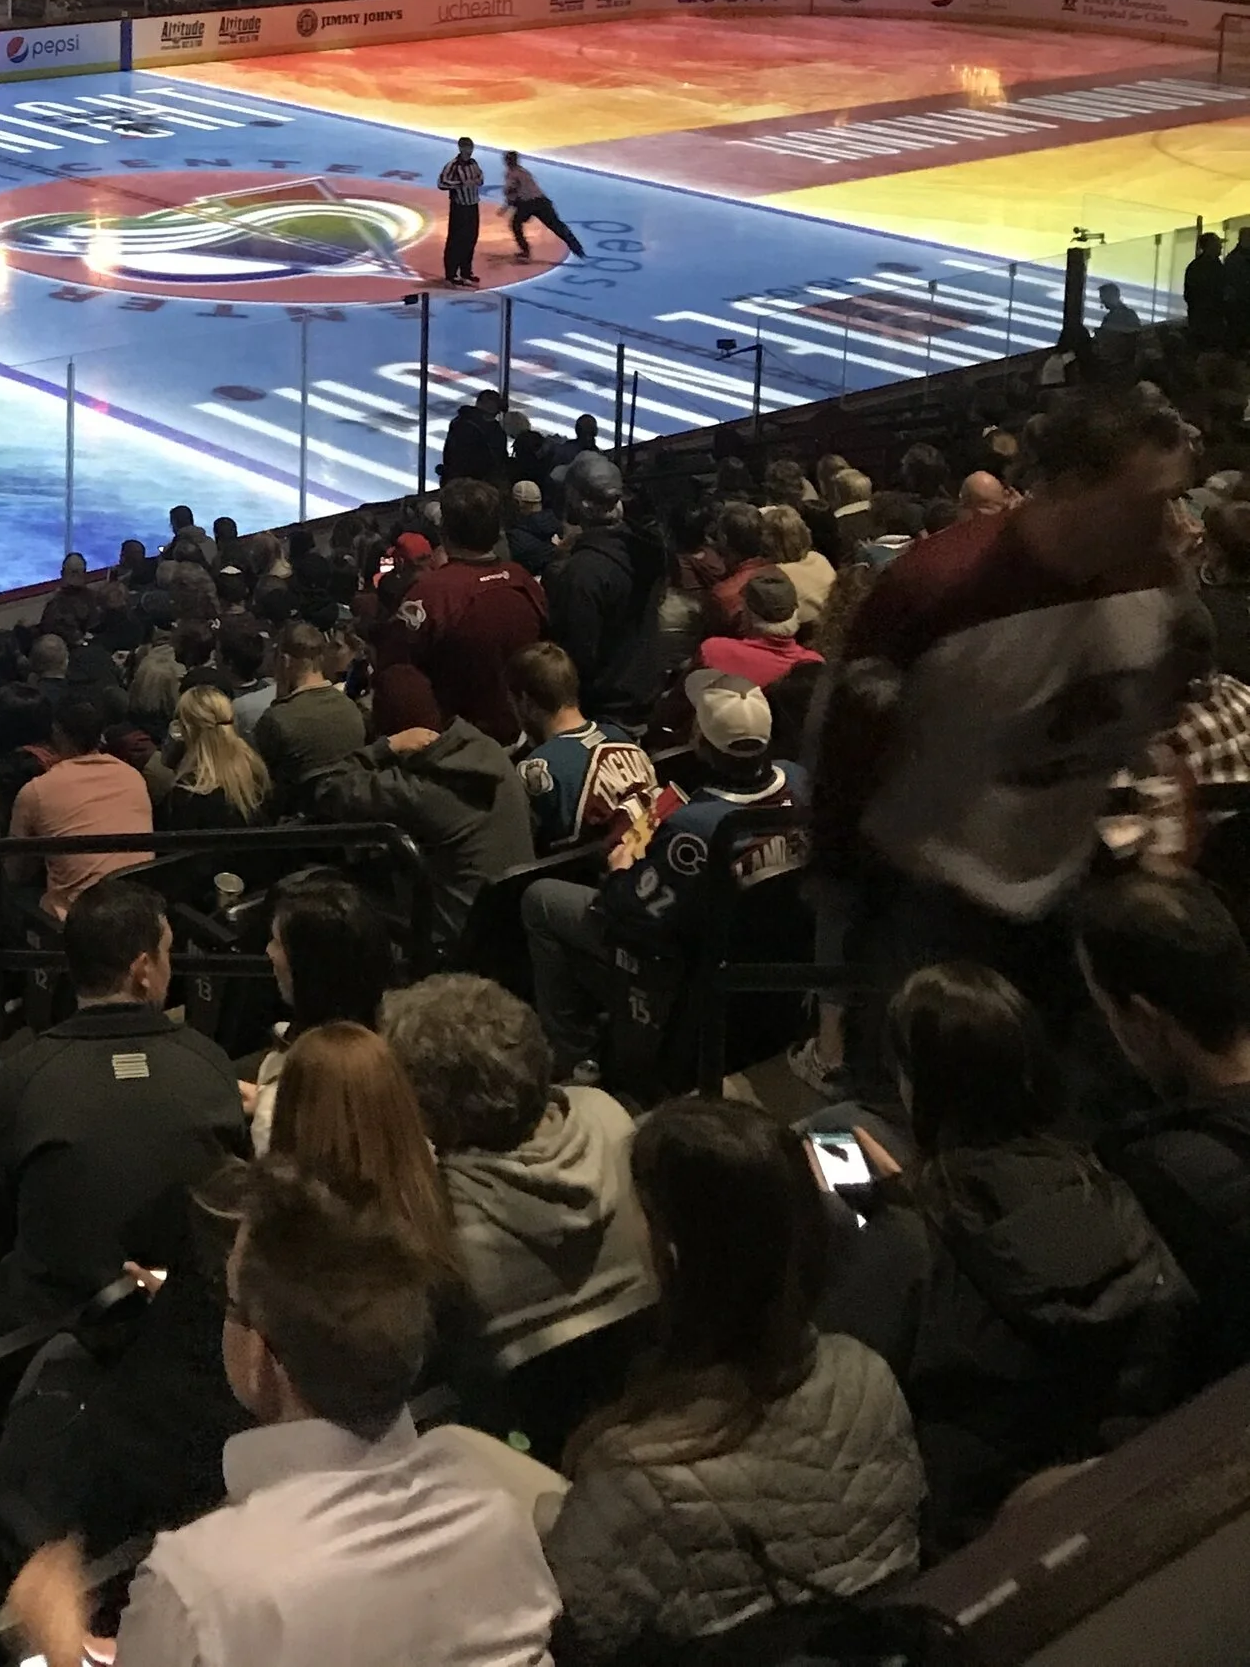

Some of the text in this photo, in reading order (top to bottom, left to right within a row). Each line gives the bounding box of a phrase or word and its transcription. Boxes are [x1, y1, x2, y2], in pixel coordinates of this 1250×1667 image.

[218, 15, 261, 34] Altitude
[321, 9, 403, 29] JIMMY JOHN'S
[161, 20, 205, 39] Altitude
[32, 34, 79, 59] pepsi
[58, 157, 424, 182] CENTER
